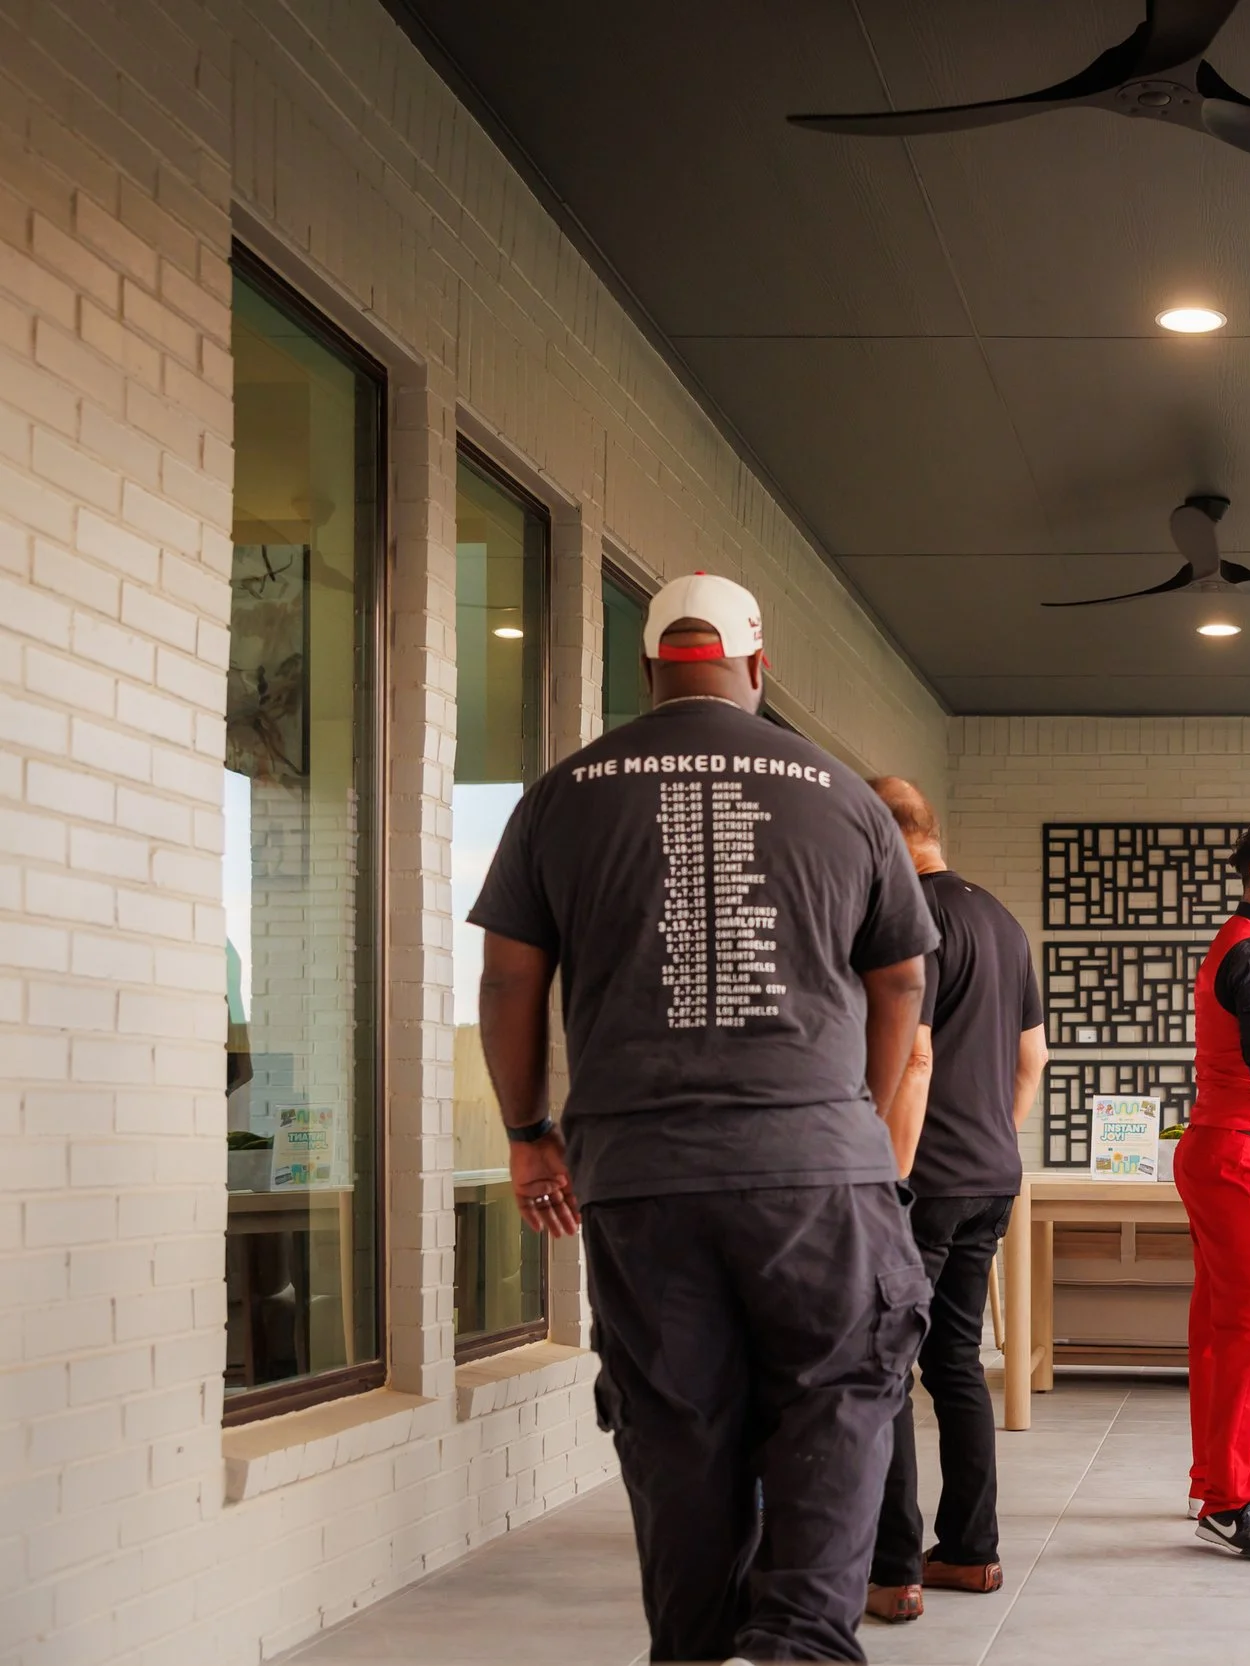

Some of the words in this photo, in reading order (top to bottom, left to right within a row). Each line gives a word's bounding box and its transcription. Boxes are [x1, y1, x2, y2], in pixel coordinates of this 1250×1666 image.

[572, 760, 618, 782] THE
[624, 755, 726, 774] MASKED
[733, 756, 831, 787] MENACE
[712, 782, 742, 790] AKRON
[712, 792, 742, 800] AKRON
[712, 802, 731, 810] NEW
[736, 802, 759, 810] YORK
[713, 812, 771, 822] SACRAMENTO
[713, 821, 753, 830] DETROIT
[713, 832, 754, 841] MEMPHIS
[713, 842, 754, 851] BEIJING
[714, 853, 754, 861] ATLANTA
[714, 863, 742, 872] MIAMI
[714, 874, 765, 883] MILWAUKEE
[714, 885, 749, 894] BOSTON
[715, 895, 743, 905] MIAMI
[715, 907, 732, 916] SAN
[737, 907, 777, 916] ANTONIO
[715, 917, 775, 930] CHARLOTTE
[715, 929, 755, 939] OAKLAND
[715, 941, 733, 950] LOS
[737, 940, 776, 950] ANGELES
[717, 951, 755, 960] TORONTO
[716, 963, 733, 972] LOS
[738, 962, 776, 973] ANGELES
[716, 974, 750, 983] DALLAS
[716, 985, 762, 994] OKLAHOMA
[766, 984, 786, 994] CITY
[716, 996, 750, 1005] DENVER
[716, 1007, 734, 1016] LOS
[738, 1006, 779, 1016] ANGELES
[716, 1017, 745, 1027] PARIS
[1104, 1123, 1147, 1133] INSTANT
